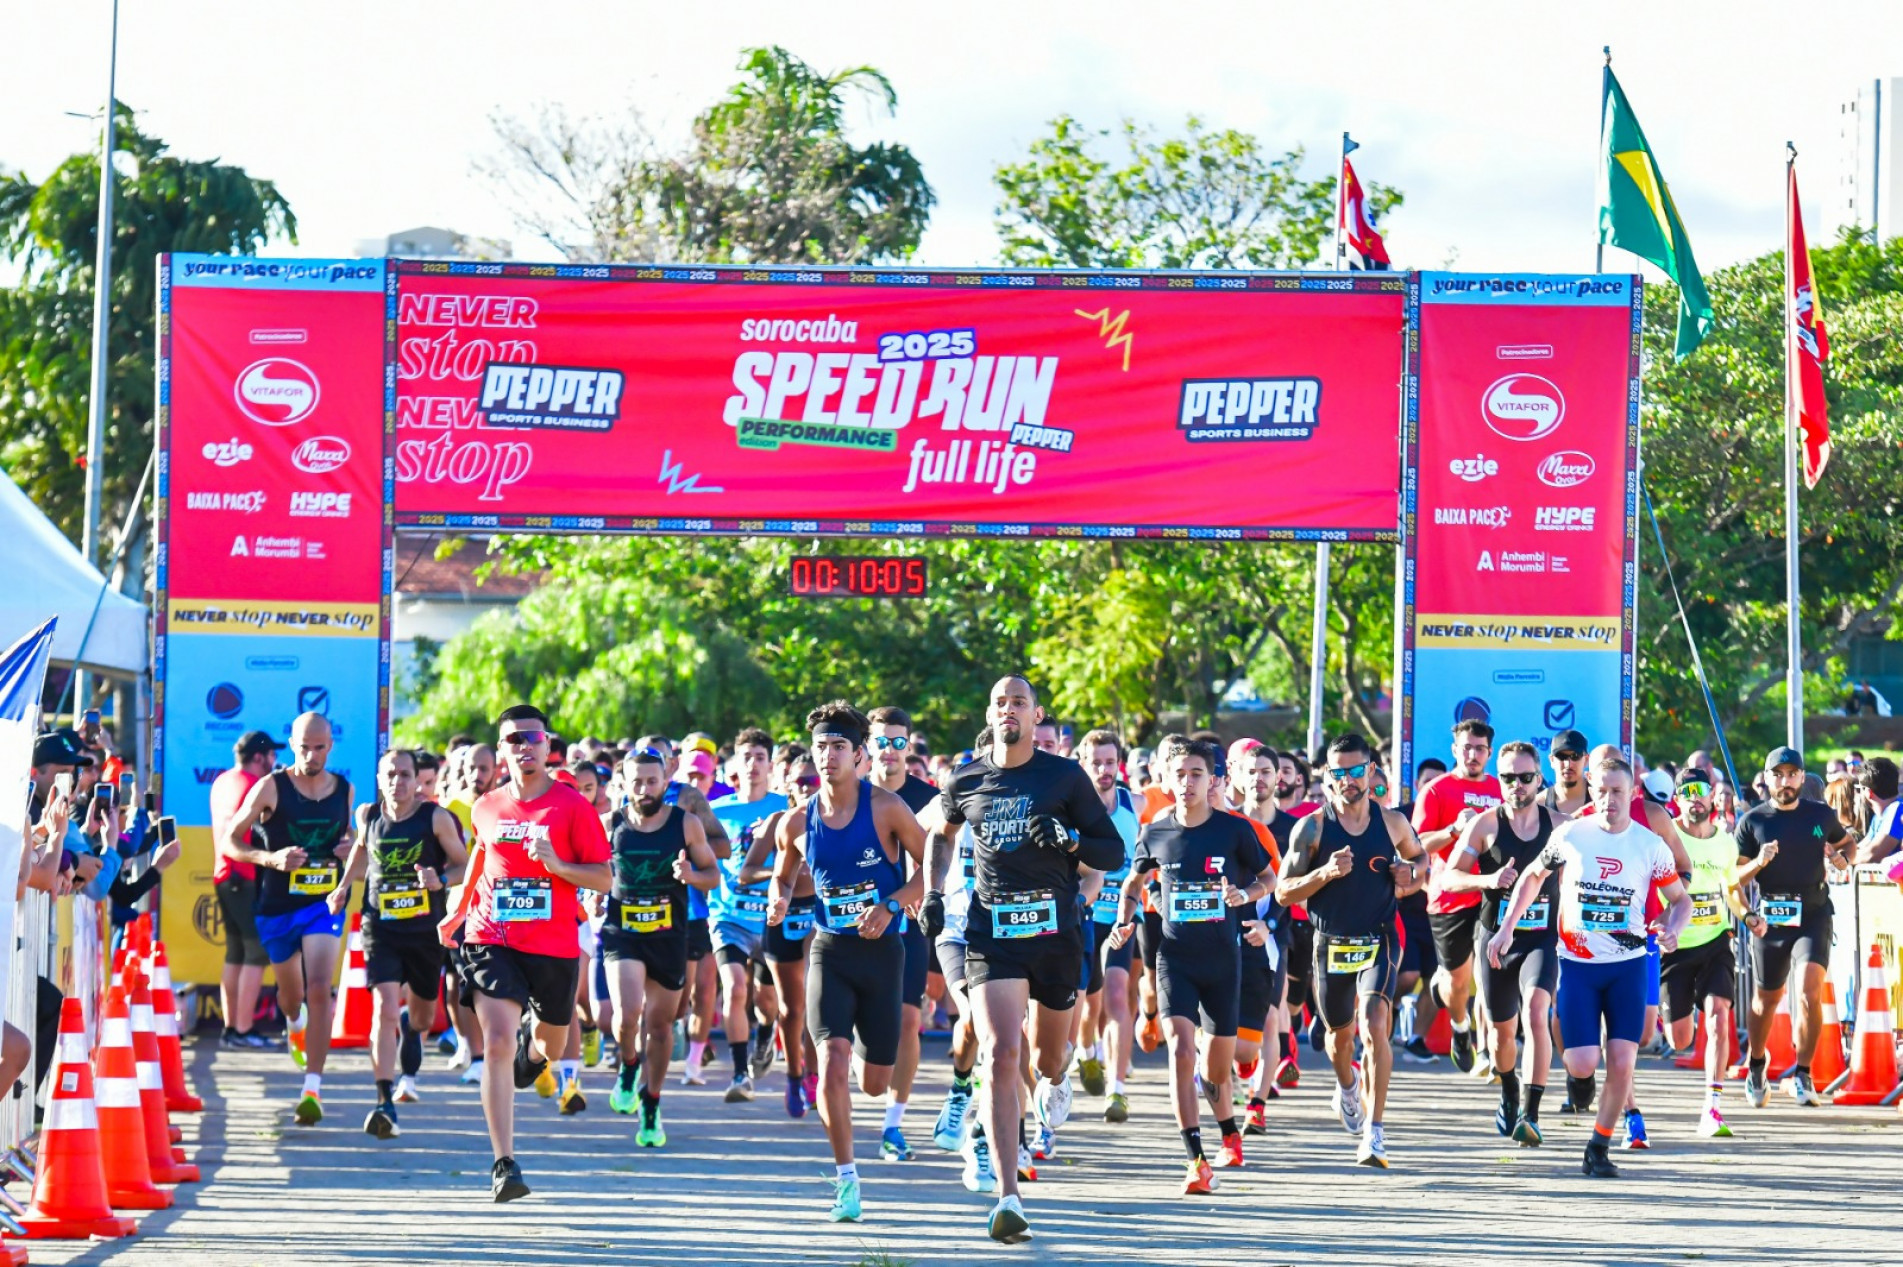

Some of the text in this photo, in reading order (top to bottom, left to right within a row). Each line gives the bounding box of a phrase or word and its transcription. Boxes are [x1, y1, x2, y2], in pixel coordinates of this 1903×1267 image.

[184, 262, 228, 277] your
[330, 266, 377, 283] pace
[423, 264, 448, 273] 2025
[476, 265, 502, 274] 2025
[530, 267, 555, 276] 2025
[583, 268, 609, 278] 2025
[637, 270, 663, 279] 2025
[690, 271, 716, 280] 2025
[744, 272, 769, 281] 2025
[796, 273, 822, 282] 2025
[850, 274, 875, 283] 2025
[902, 275, 928, 284] 2025
[956, 276, 981, 284] 2025
[1008, 276, 1035, 286] 2025
[1062, 278, 1088, 286] 2025
[1115, 278, 1141, 287] 2025
[1168, 278, 1194, 287] 2025
[1221, 279, 1247, 288] 2025
[1275, 280, 1300, 288] 2025
[1327, 280, 1353, 289] 2025
[1410, 284, 1419, 306] 2025
[1433, 279, 1477, 295] your
[1577, 281, 1623, 298] pace
[1634, 287, 1642, 310] 2025
[398, 294, 539, 328] NEVER
[740, 314, 858, 343] sorocaba
[880, 331, 976, 360] 2025
[1632, 334, 1640, 356] 2025
[250, 387, 303, 397] VITAFOR
[481, 364, 622, 415] PEPPER
[722, 352, 1059, 432] SPEED RUN
[1409, 376, 1417, 399] 2025
[1630, 380, 1639, 402] 2025
[1181, 380, 1319, 425] PEPPER
[1497, 402, 1550, 412] VITAFOR
[489, 413, 610, 429] SPORTS BUSINESS
[739, 438, 778, 448] edition
[741, 420, 892, 447] PERFORMANCE
[1010, 423, 1073, 451] PEPPER
[1190, 428, 1309, 439] SPORTS BUSINESS
[202, 437, 254, 462] ezie
[395, 432, 533, 501] stop
[902, 439, 1036, 494] full life
[1450, 454, 1499, 476] ezie
[1407, 468, 1416, 490] 2025
[1628, 471, 1636, 493] 2025
[187, 492, 251, 511] BAIXA PACE
[290, 492, 352, 511] HYPE
[1434, 508, 1496, 526] BAIXA PACE
[1535, 507, 1596, 525] HYPE
[472, 516, 498, 526] 2025
[578, 518, 605, 528] 2025
[685, 520, 711, 530] 2025
[791, 521, 818, 531] 2025
[897, 523, 923, 533] 2025
[1004, 525, 1030, 534] 2025
[1109, 527, 1136, 537] 2025
[1215, 529, 1241, 538] 2025
[1321, 530, 1347, 540] 2025
[230, 535, 249, 557] A
[256, 536, 300, 548] Anhembi
[255, 548, 300, 558] Morumbi
[1476, 550, 1495, 571] A
[1501, 551, 1545, 561] Anhembi
[792, 558, 924, 594] 00:10:05
[1406, 560, 1415, 582] 2025
[1501, 562, 1545, 572] Morumbi
[1625, 562, 1634, 584] 2025
[174, 608, 374, 630] NEVER stop NEVER stop
[1422, 623, 1616, 643] NEVER stop NEVER stop
[1405, 651, 1414, 673] 2025
[1624, 654, 1632, 676] 2025
[984, 797, 1030, 821] JM
[994, 836, 1024, 844] GROUP
[305, 875, 324, 884] 327
[392, 898, 415, 909] 309
[508, 897, 534, 909] 709
[744, 902, 764, 912] 651
[1100, 892, 1118, 902] 753
[1184, 899, 1209, 910] 555
[635, 912, 657, 922] 182
[838, 901, 865, 915] 766
[1010, 912, 1038, 925] 849
[1591, 911, 1615, 922] 725
[1344, 952, 1366, 963] 146
